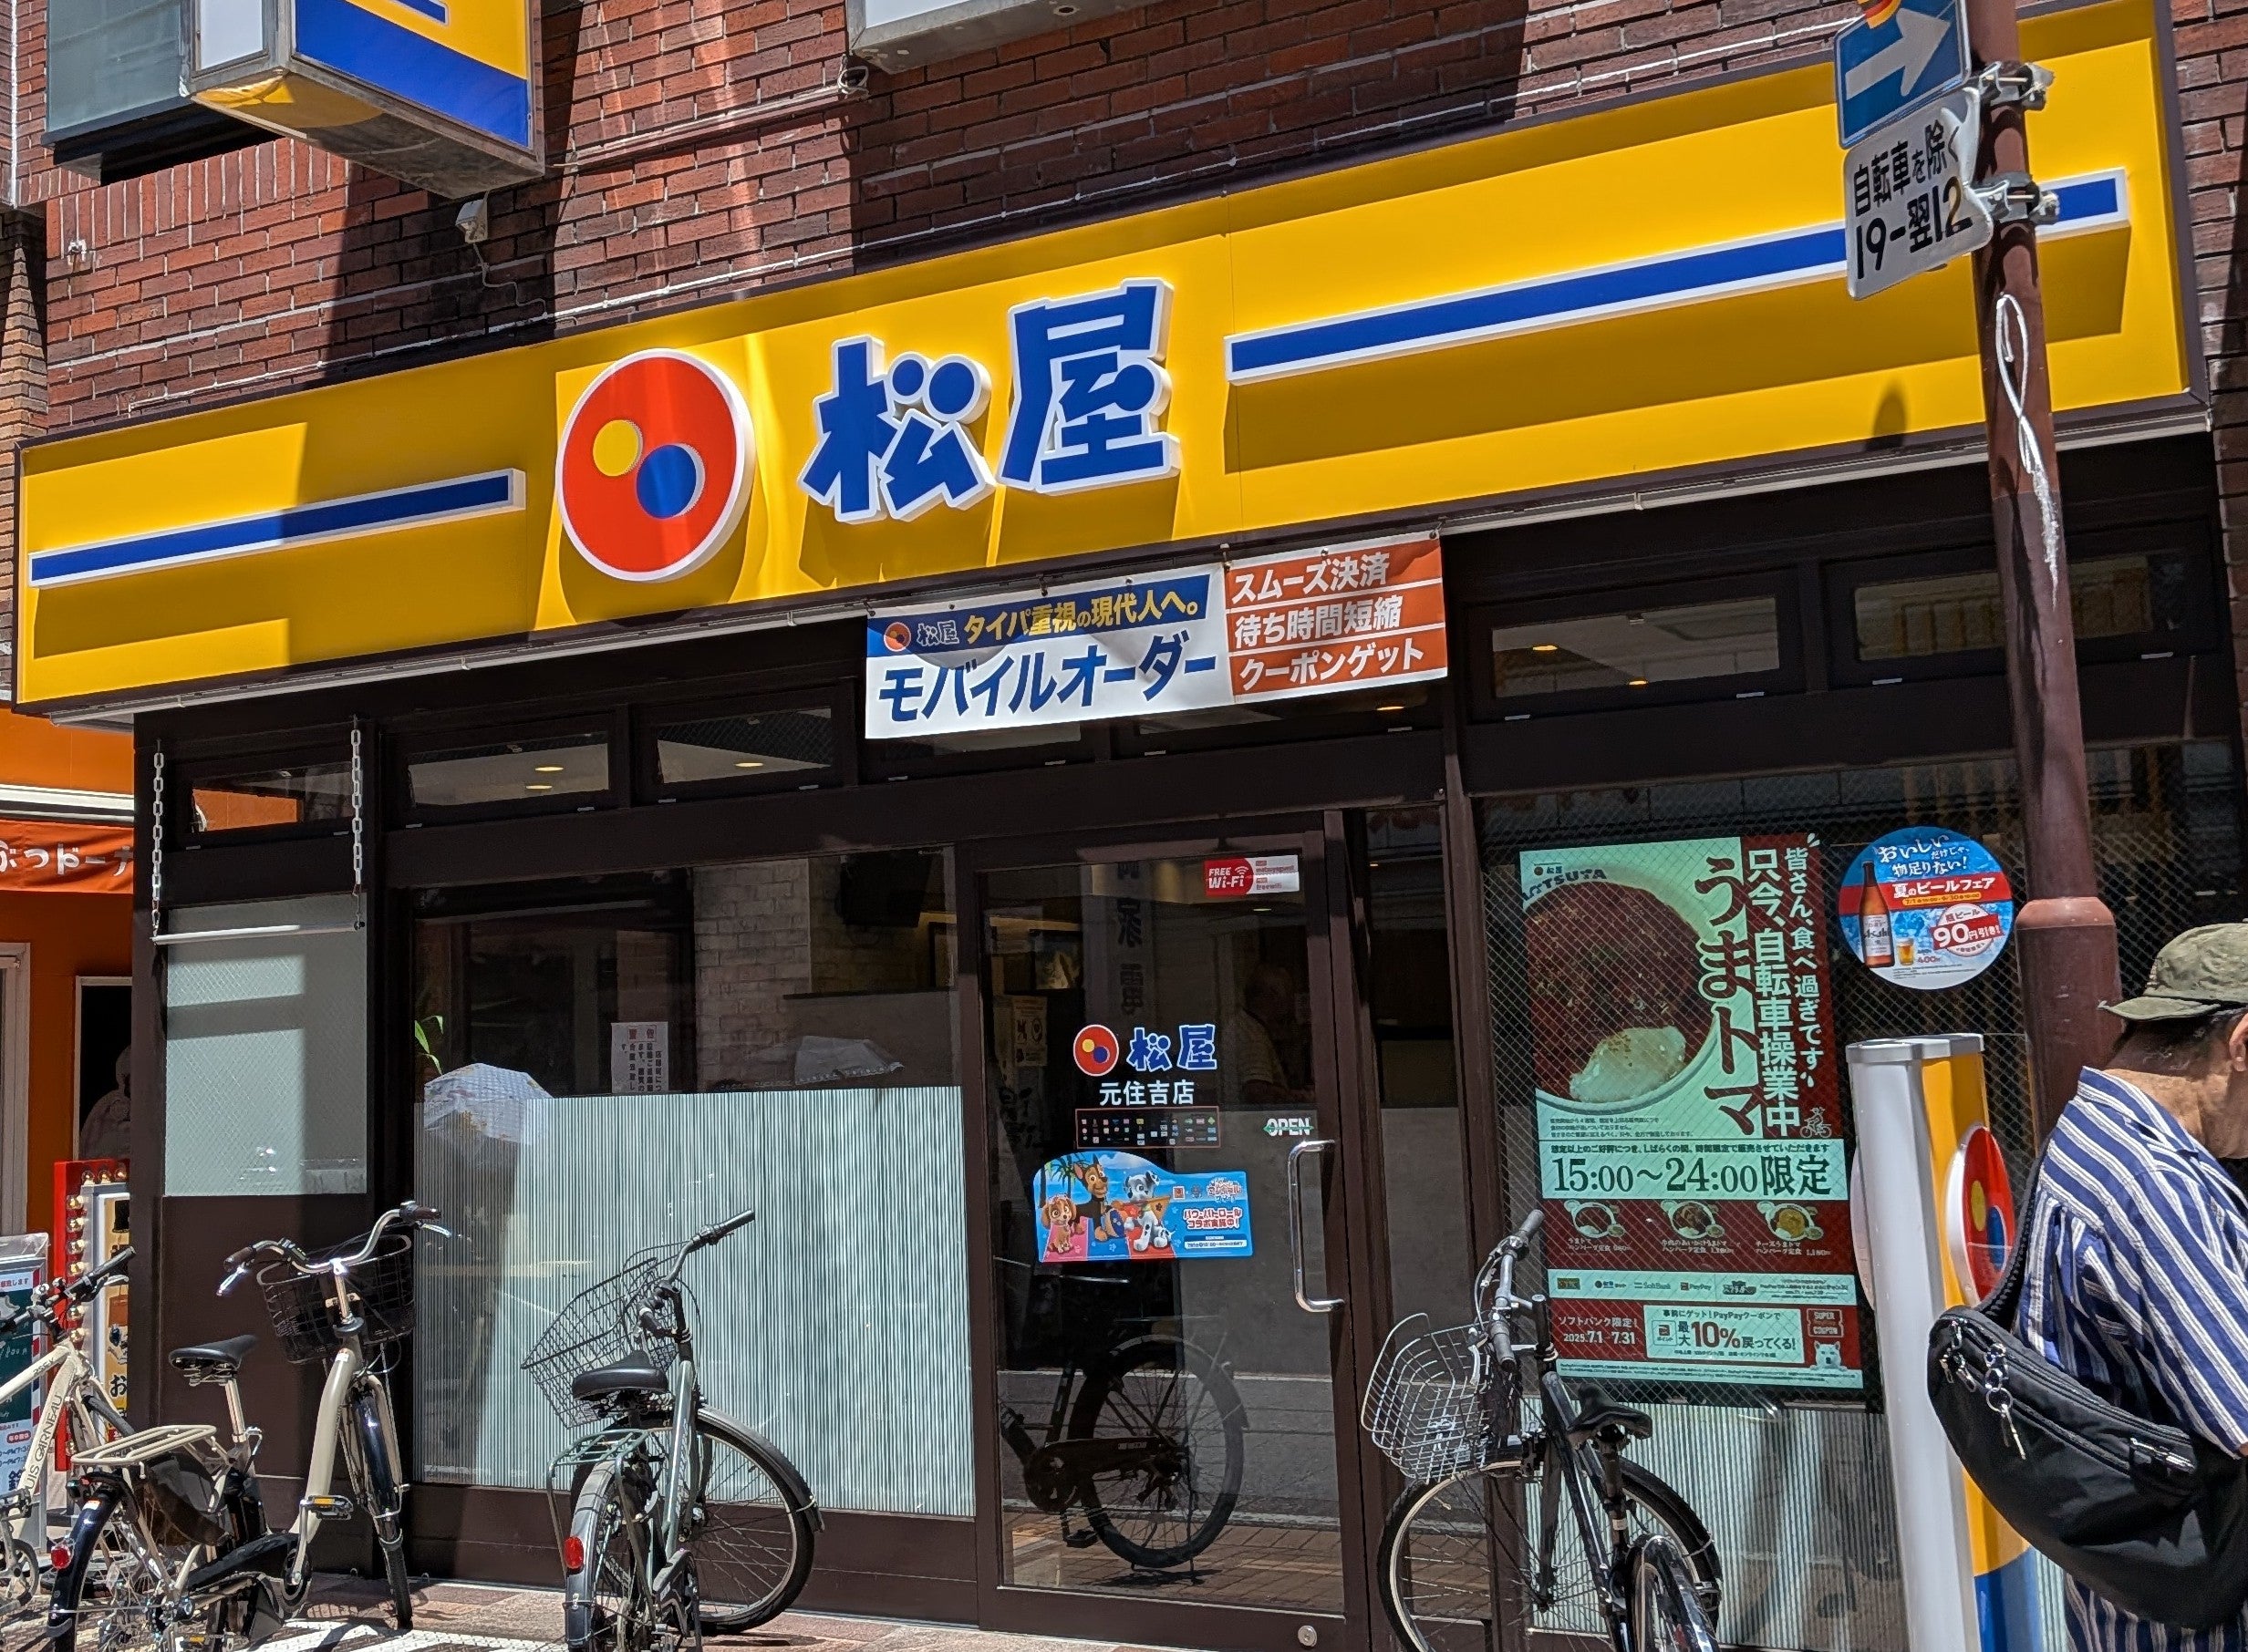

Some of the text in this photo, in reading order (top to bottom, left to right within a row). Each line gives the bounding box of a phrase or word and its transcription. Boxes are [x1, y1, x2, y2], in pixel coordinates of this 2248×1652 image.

[1853, 119, 1959, 217] 自転車を除く
[799, 279, 1176, 521] 松屋
[1231, 552, 1391, 604] スムーズ決済
[917, 590, 1199, 646] 松屋 タイパ重視の現代人へ。
[1234, 595, 1404, 649] 待ち時間短縮
[879, 630, 1217, 722] モバイルオーダー
[1239, 638, 1424, 691] クーポンゲット
[1208, 866, 1232, 877] FREE
[1875, 835, 1950, 863] おいしい
[1208, 875, 1245, 889] Wi-Fi
[1892, 877, 1996, 899] 夏のビールフェア
[1784, 847, 1824, 1071] 皆さん、食べ過ぎです
[1694, 856, 1761, 1136] うまトマ
[1747, 849, 1801, 1137] 只今、自転車操業中
[1126, 1024, 1217, 1072] 松屋
[1099, 1079, 1195, 1106] 元住吉店
[1266, 1118, 1310, 1137] OPEN
